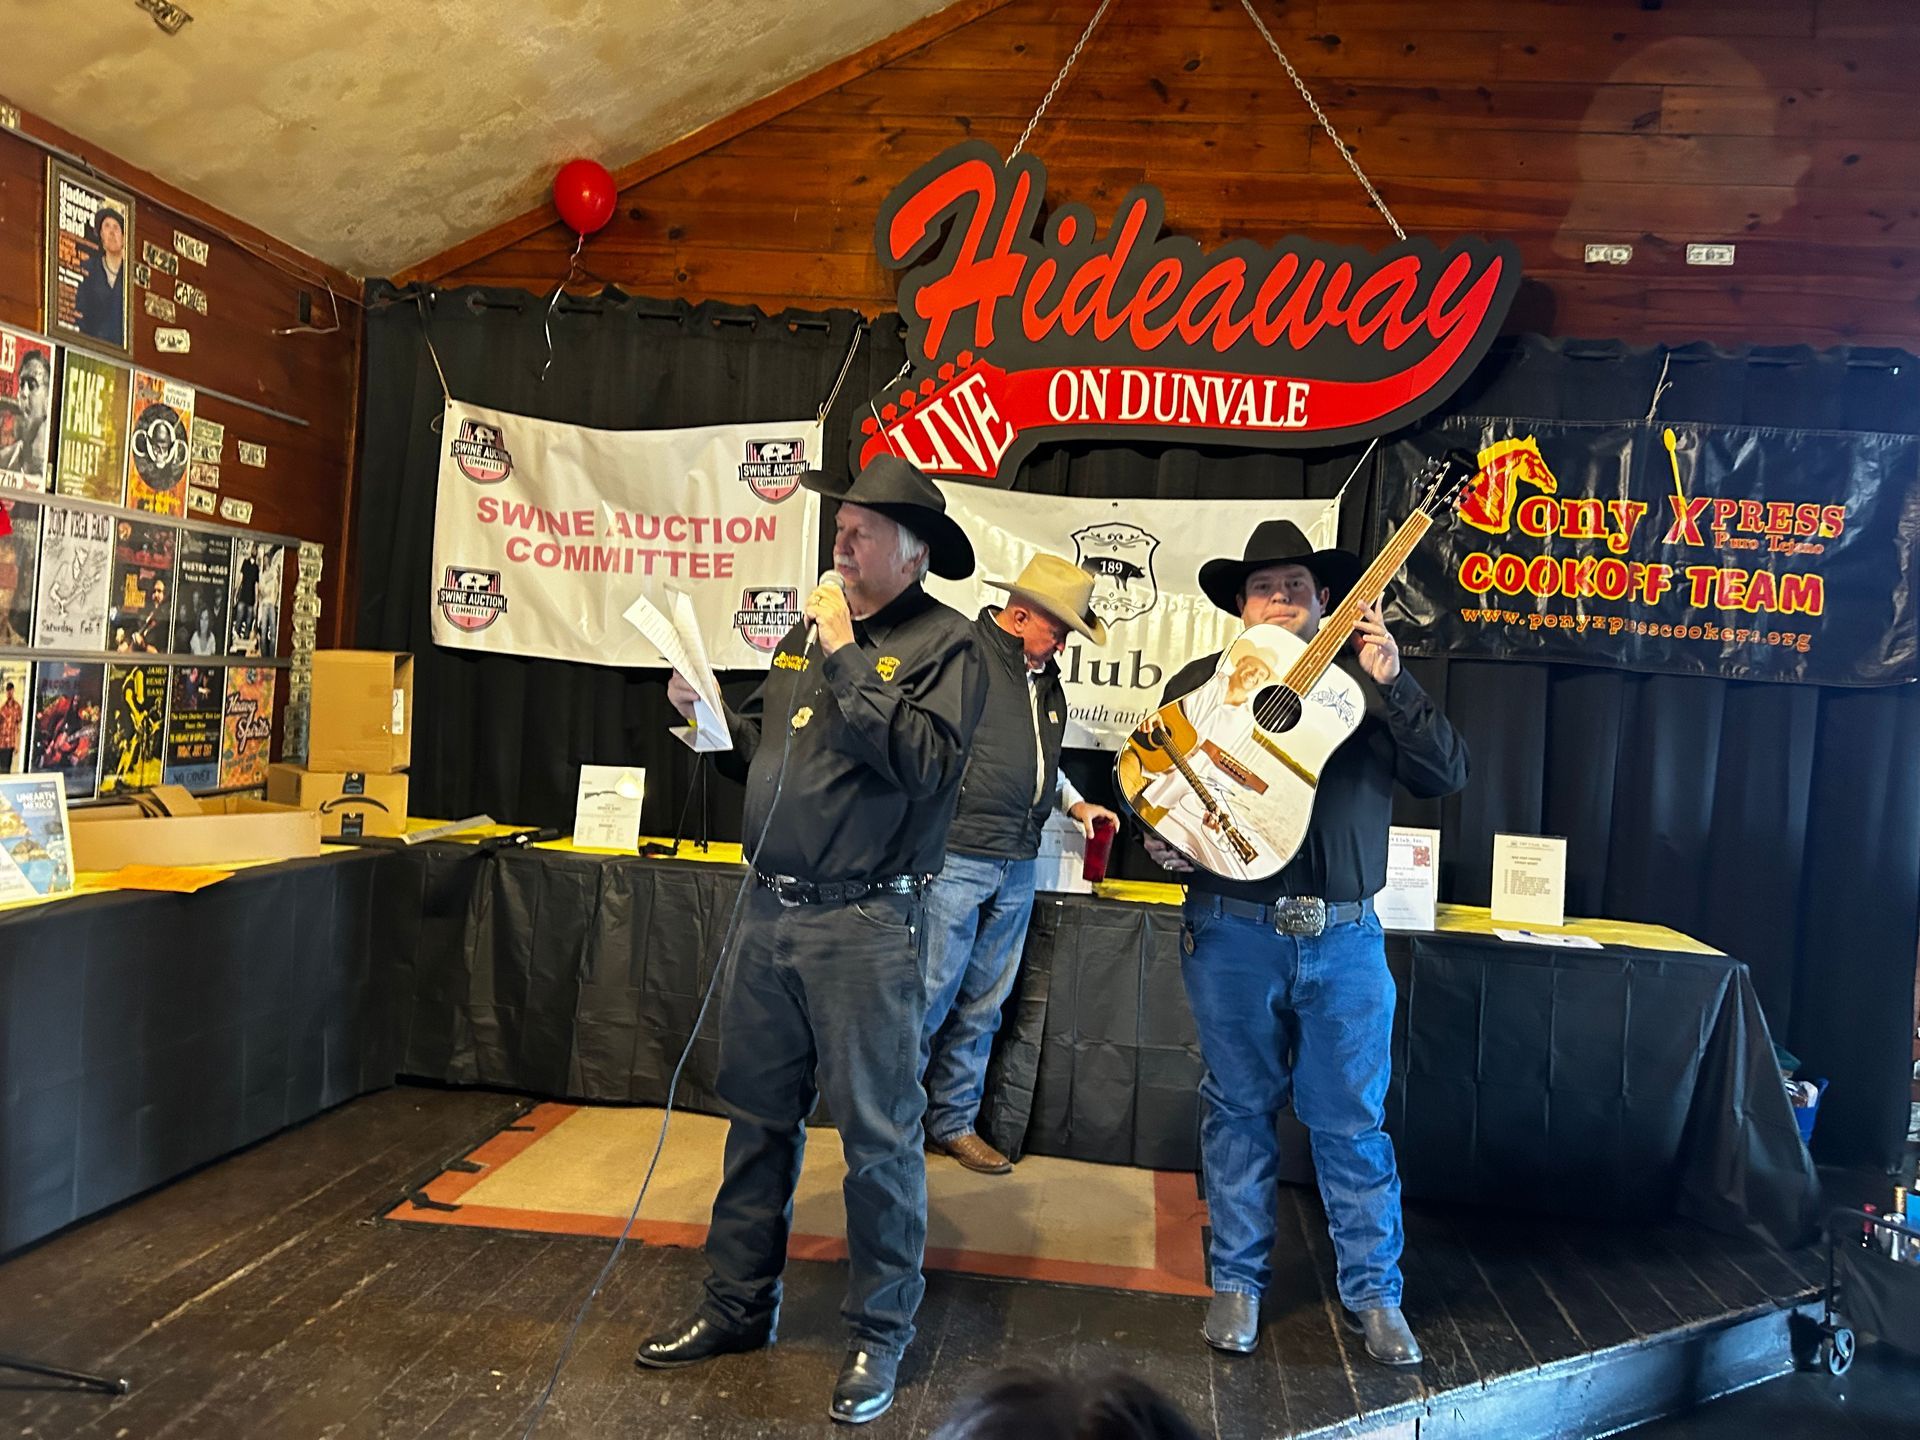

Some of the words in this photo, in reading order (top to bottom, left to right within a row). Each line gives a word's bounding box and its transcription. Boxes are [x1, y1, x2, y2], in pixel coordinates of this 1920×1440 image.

[59, 181, 97, 212] Hadden
[59, 198, 96, 228] Sayers
[59, 213, 85, 238] Band
[889, 160, 1503, 359] Hideaway
[66, 367, 105, 438] FAKE
[1048, 368, 1113, 422] ON
[1119, 371, 1310, 428] DUNVALE
[889, 372, 1016, 471] LIVE
[454, 441, 483, 457] SWINE
[743, 464, 772, 477] SWINE
[773, 462, 806, 476] AUCTION
[476, 496, 595, 537] SWINE
[606, 511, 777, 544] AUCTION
[506, 537, 735, 580] COMMITTEE
[1099, 560, 1123, 575] 189
[440, 590, 467, 604] SWINE
[468, 593, 503, 608] AUCTION
[1459, 552, 1673, 605] COOKOFF
[1684, 565, 1825, 617] TEAM
[737, 612, 764, 625] SWINE
[765, 612, 800, 625] AUCTION
[1059, 644, 1162, 690] lub
[1114, 708, 1148, 725] and
[16, 792, 56, 803] UNEARTH
